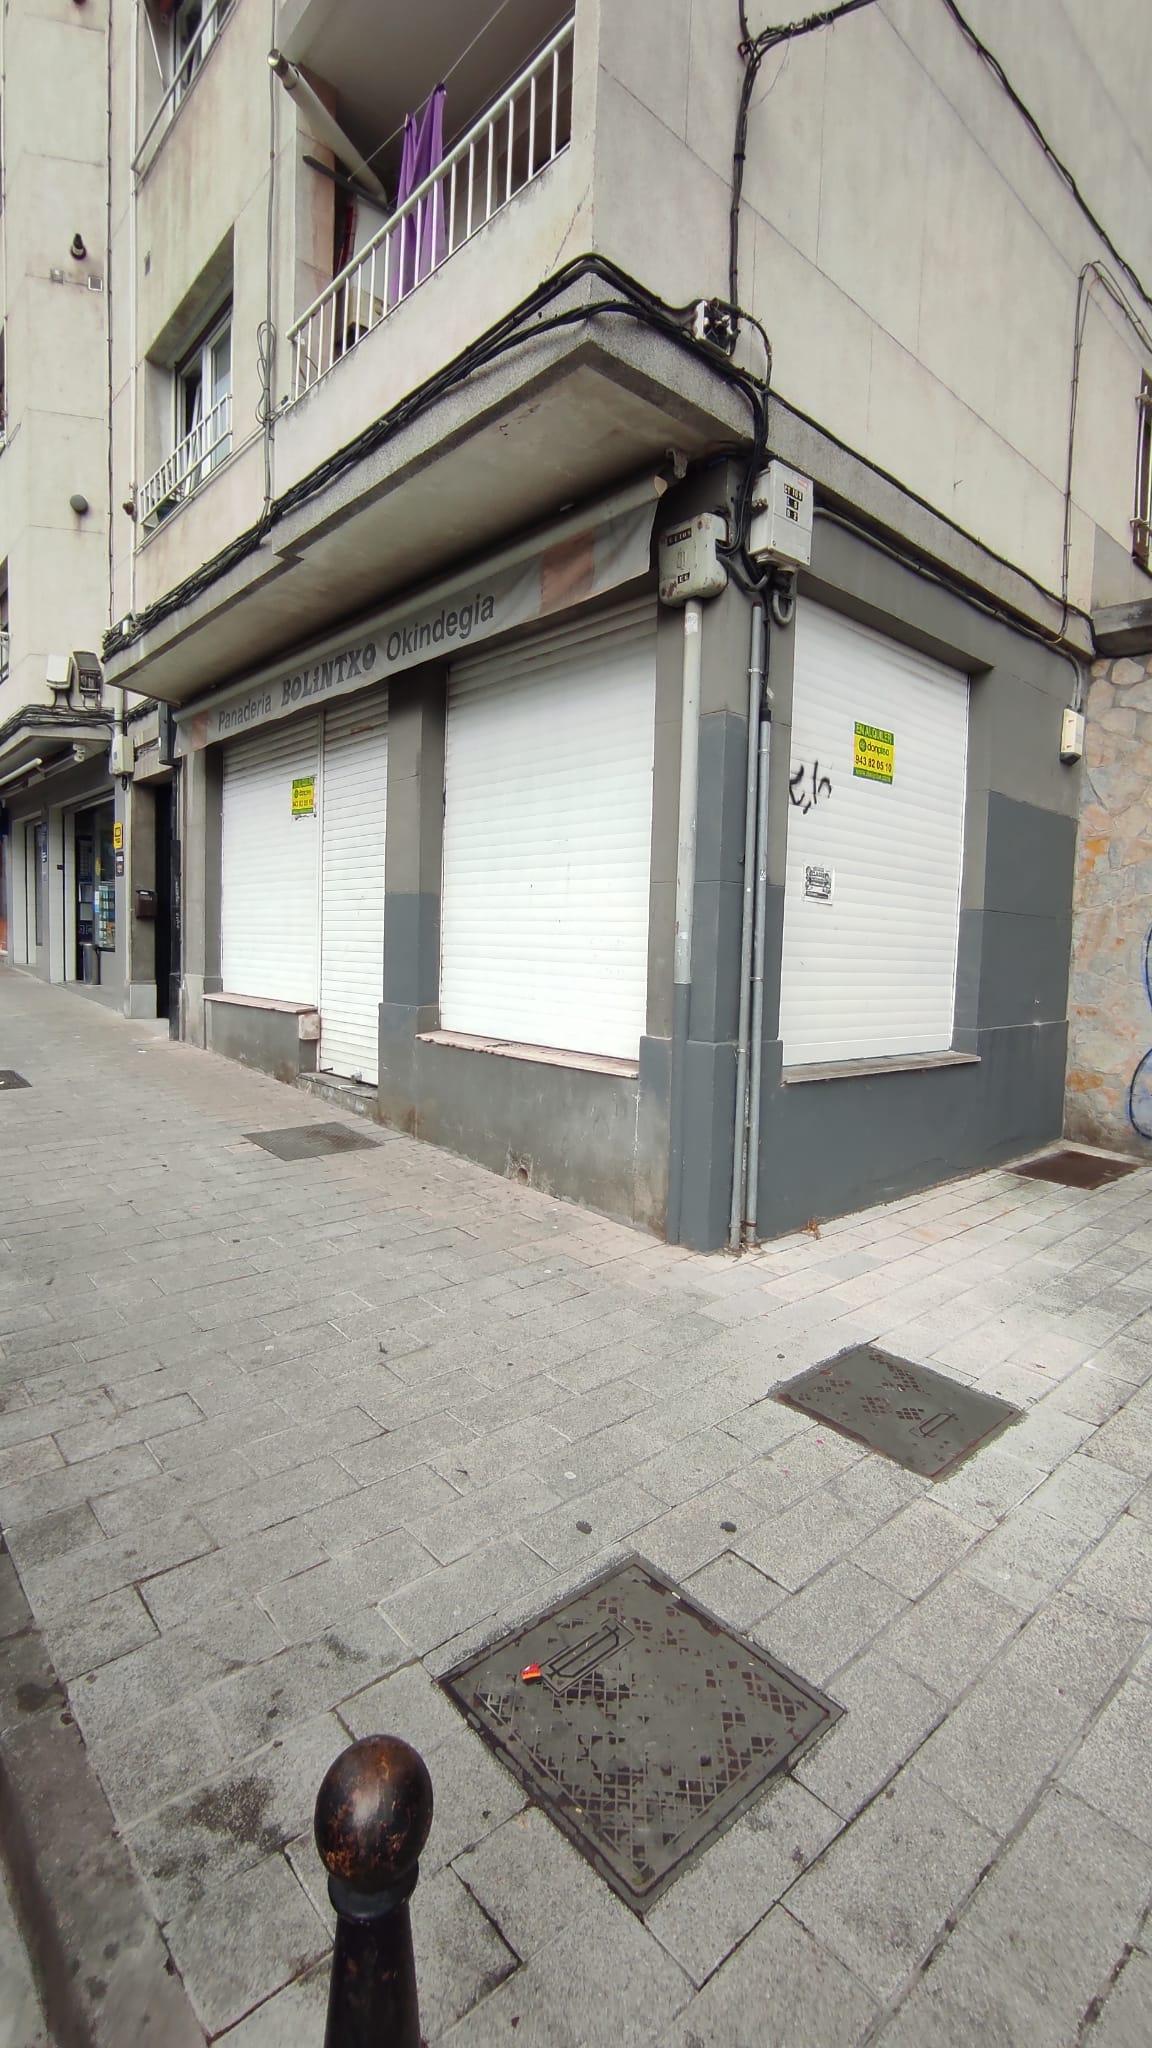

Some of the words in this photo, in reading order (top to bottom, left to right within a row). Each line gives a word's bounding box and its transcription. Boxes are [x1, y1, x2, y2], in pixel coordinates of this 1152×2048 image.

[217, 692, 272, 732] Panaderia
[386, 593, 496, 662] Okindegia
[856, 754, 867, 766] 943
[868, 758, 876, 768] 82
[876, 760, 884, 771] 05
